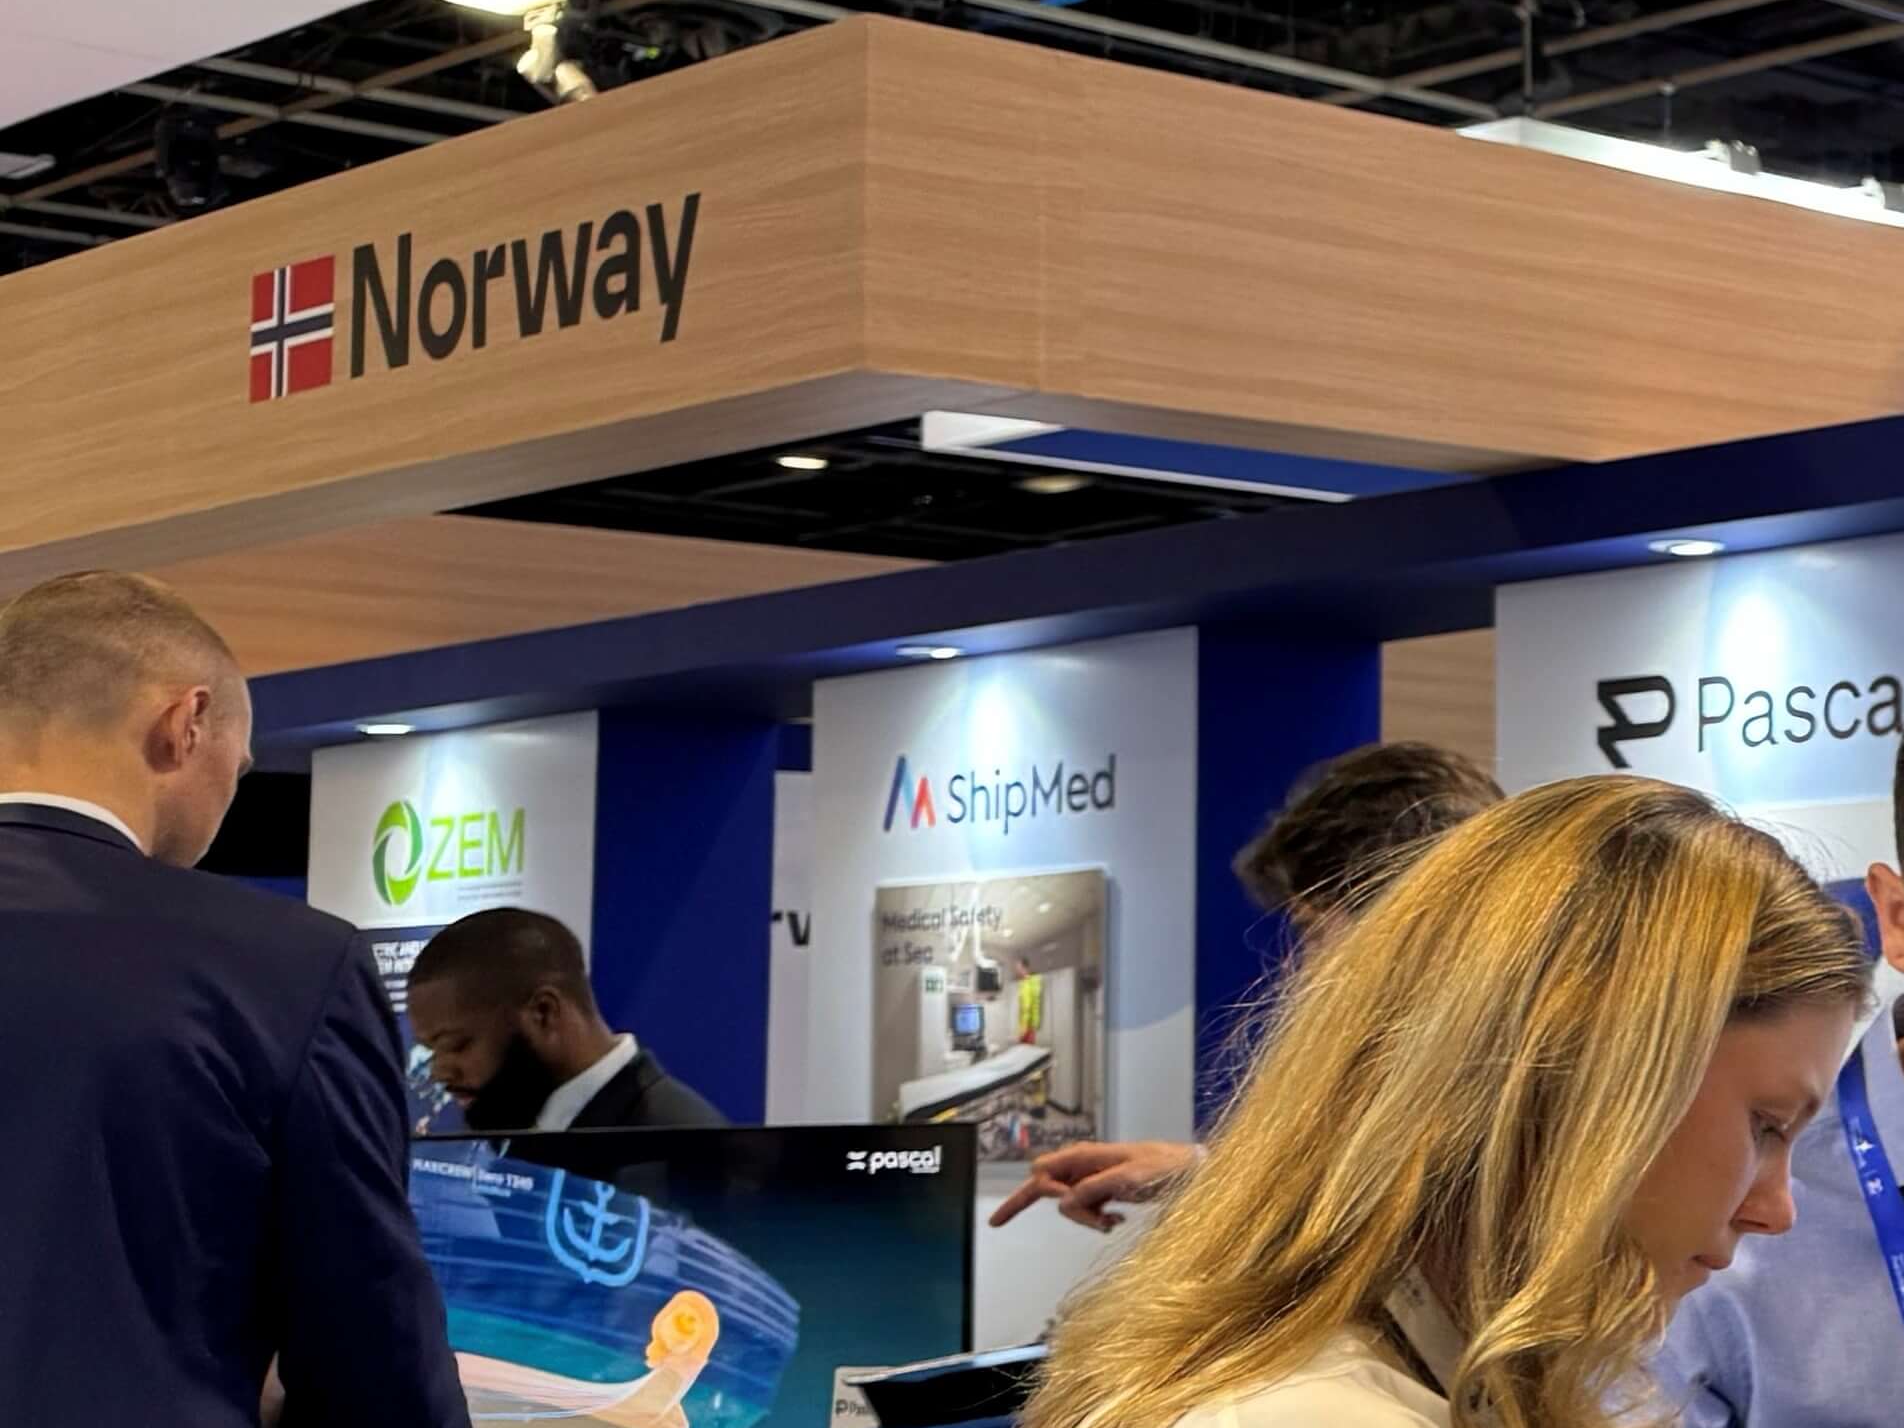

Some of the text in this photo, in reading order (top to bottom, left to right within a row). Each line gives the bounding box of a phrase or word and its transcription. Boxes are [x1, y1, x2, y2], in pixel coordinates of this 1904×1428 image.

[350, 192, 701, 379] Norway
[946, 753, 1117, 835] ShipMed
[426, 806, 526, 883] ZEM
[882, 904, 1003, 932] Medical Safety
